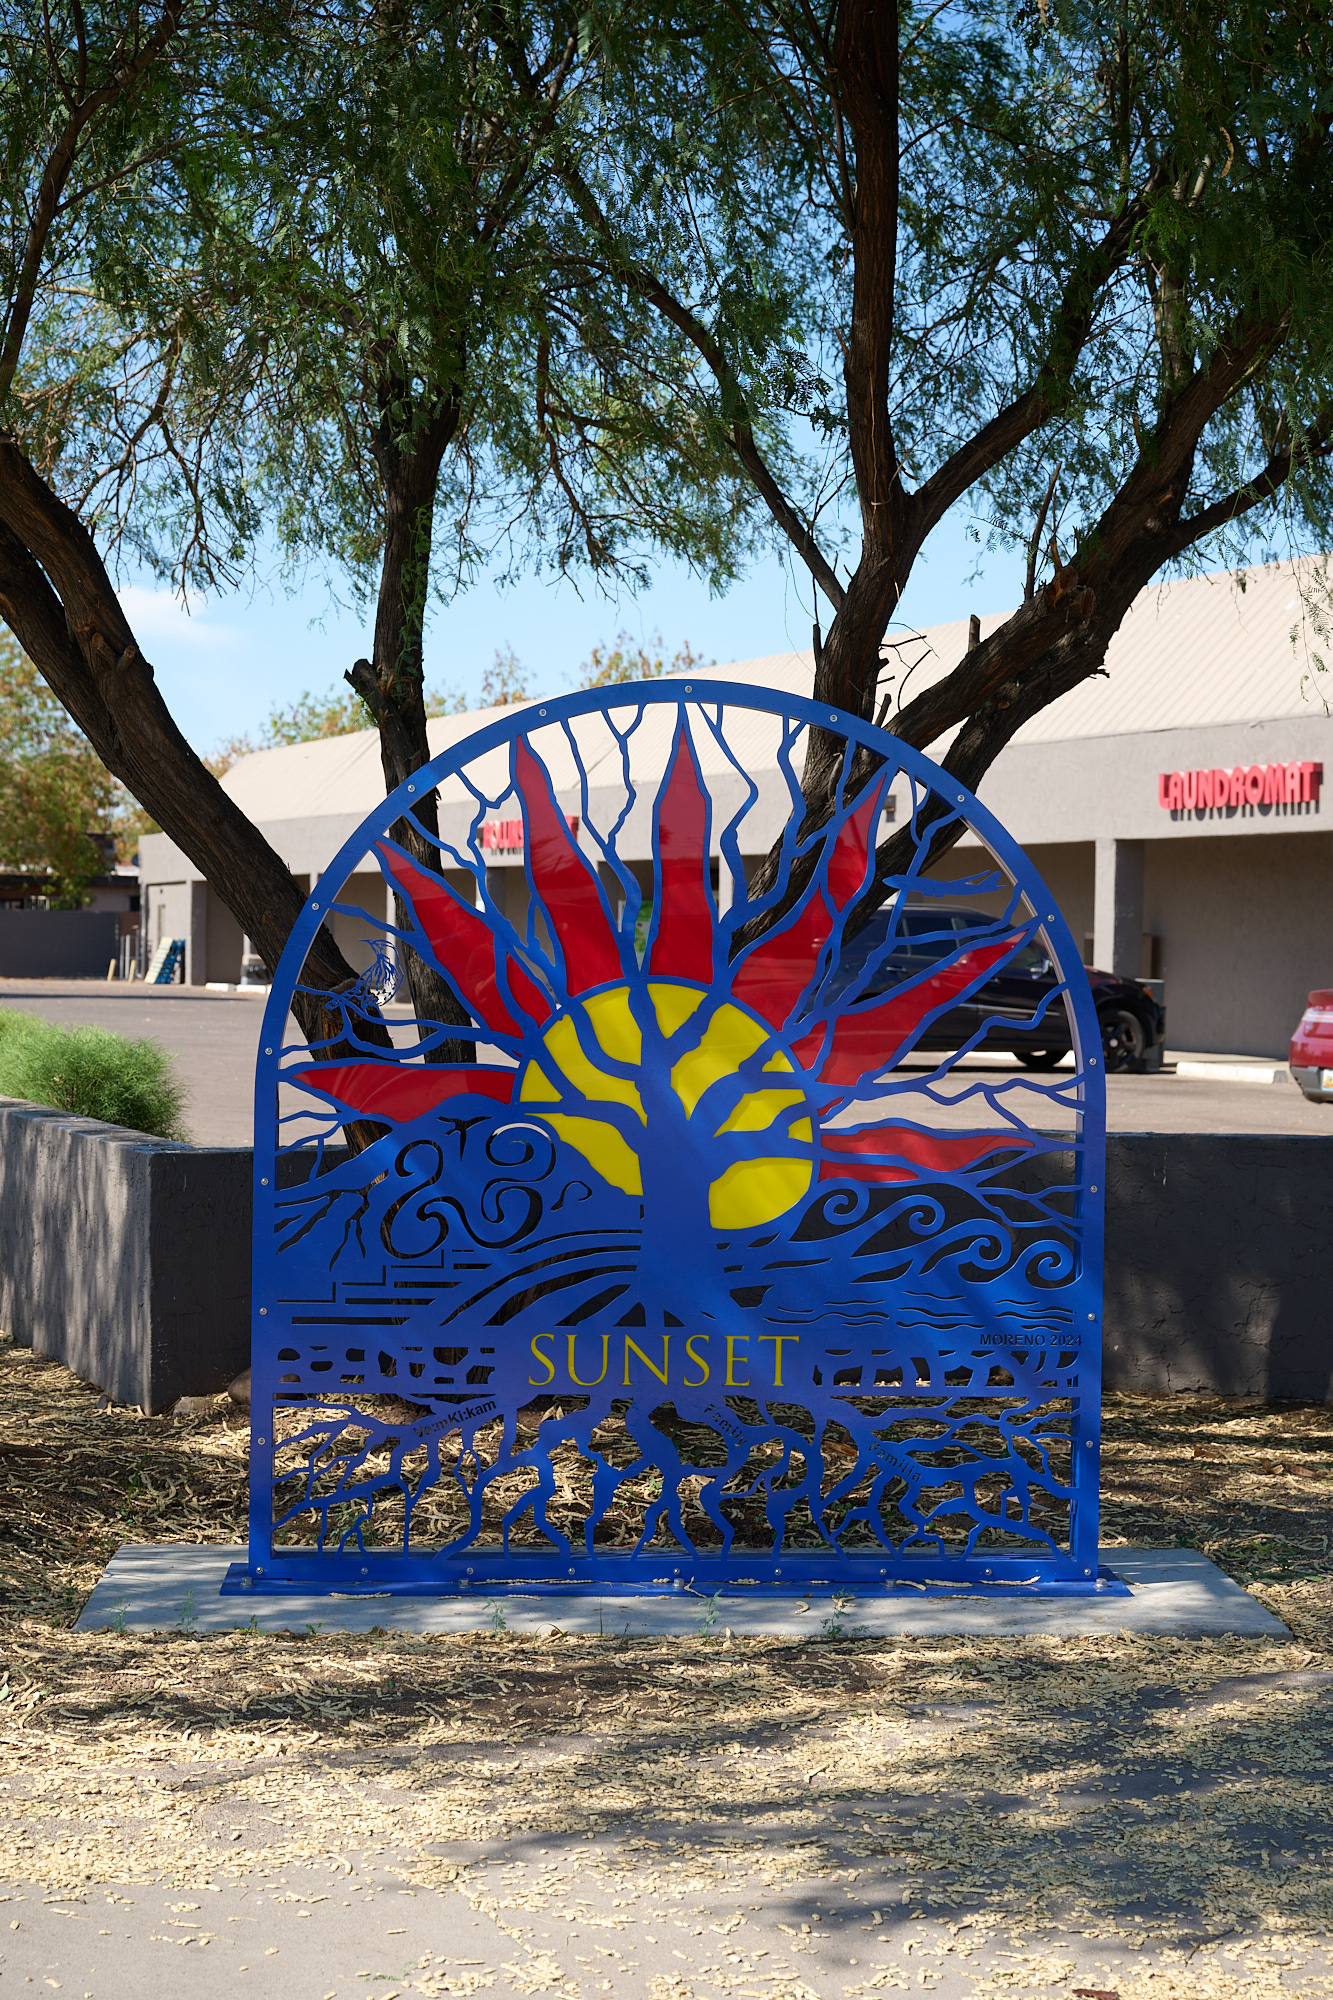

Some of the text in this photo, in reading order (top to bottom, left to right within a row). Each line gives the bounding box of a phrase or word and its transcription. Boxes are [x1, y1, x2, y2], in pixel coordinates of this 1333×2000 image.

[1158, 761, 1322, 810] LAUNDROMAT
[528, 1333, 800, 1386] SUNSET
[980, 1334, 1082, 1346] MORENO 2024
[703, 1403, 748, 1447] Family
[868, 1441, 921, 1482] Familia
